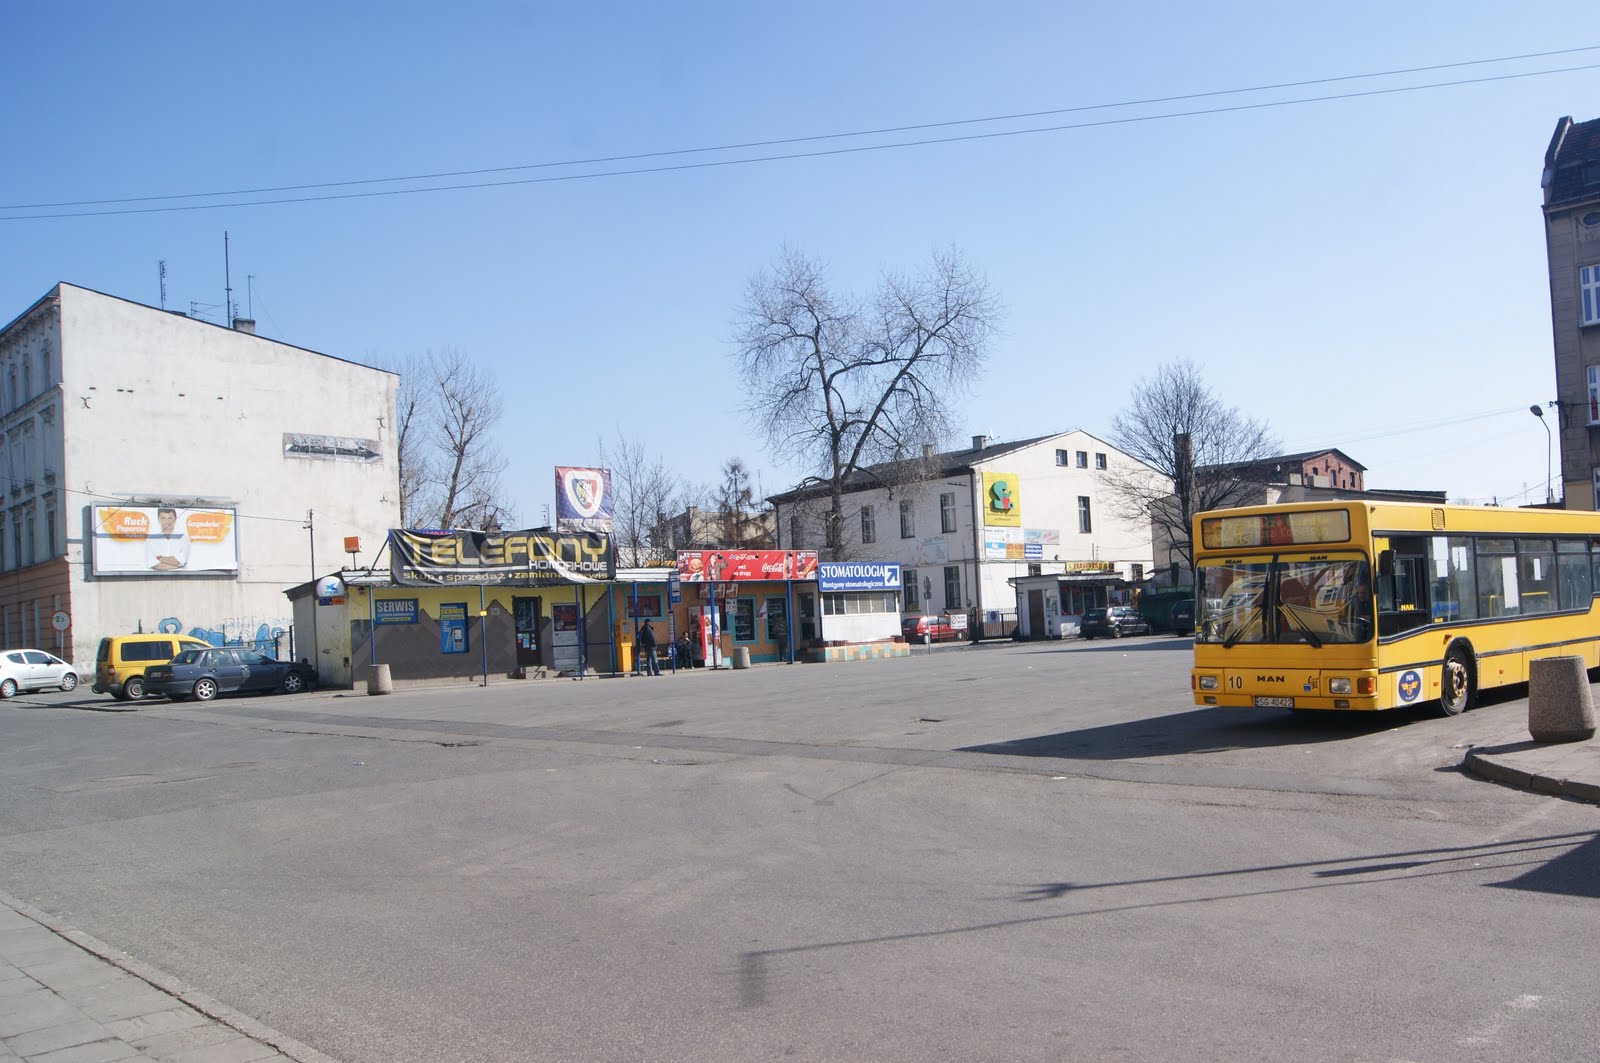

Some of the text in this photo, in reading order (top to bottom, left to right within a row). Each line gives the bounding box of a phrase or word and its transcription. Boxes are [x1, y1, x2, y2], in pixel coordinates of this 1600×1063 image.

[124, 517, 147, 526] Ruch
[403, 535, 607, 565] TELEFONY
[403, 571, 435, 582] skup
[446, 571, 506, 583] sprzedaż
[514, 570, 563, 580] zamiana
[821, 565, 885, 578] STOMATOLOGIA
[822, 580, 883, 589] Rentgeny stomatologiczne
[377, 601, 415, 613] SERWIS
[1401, 603, 1415, 611] MAN
[1229, 676, 1242, 689] 10
[1260, 697, 1292, 707] SG 40422
